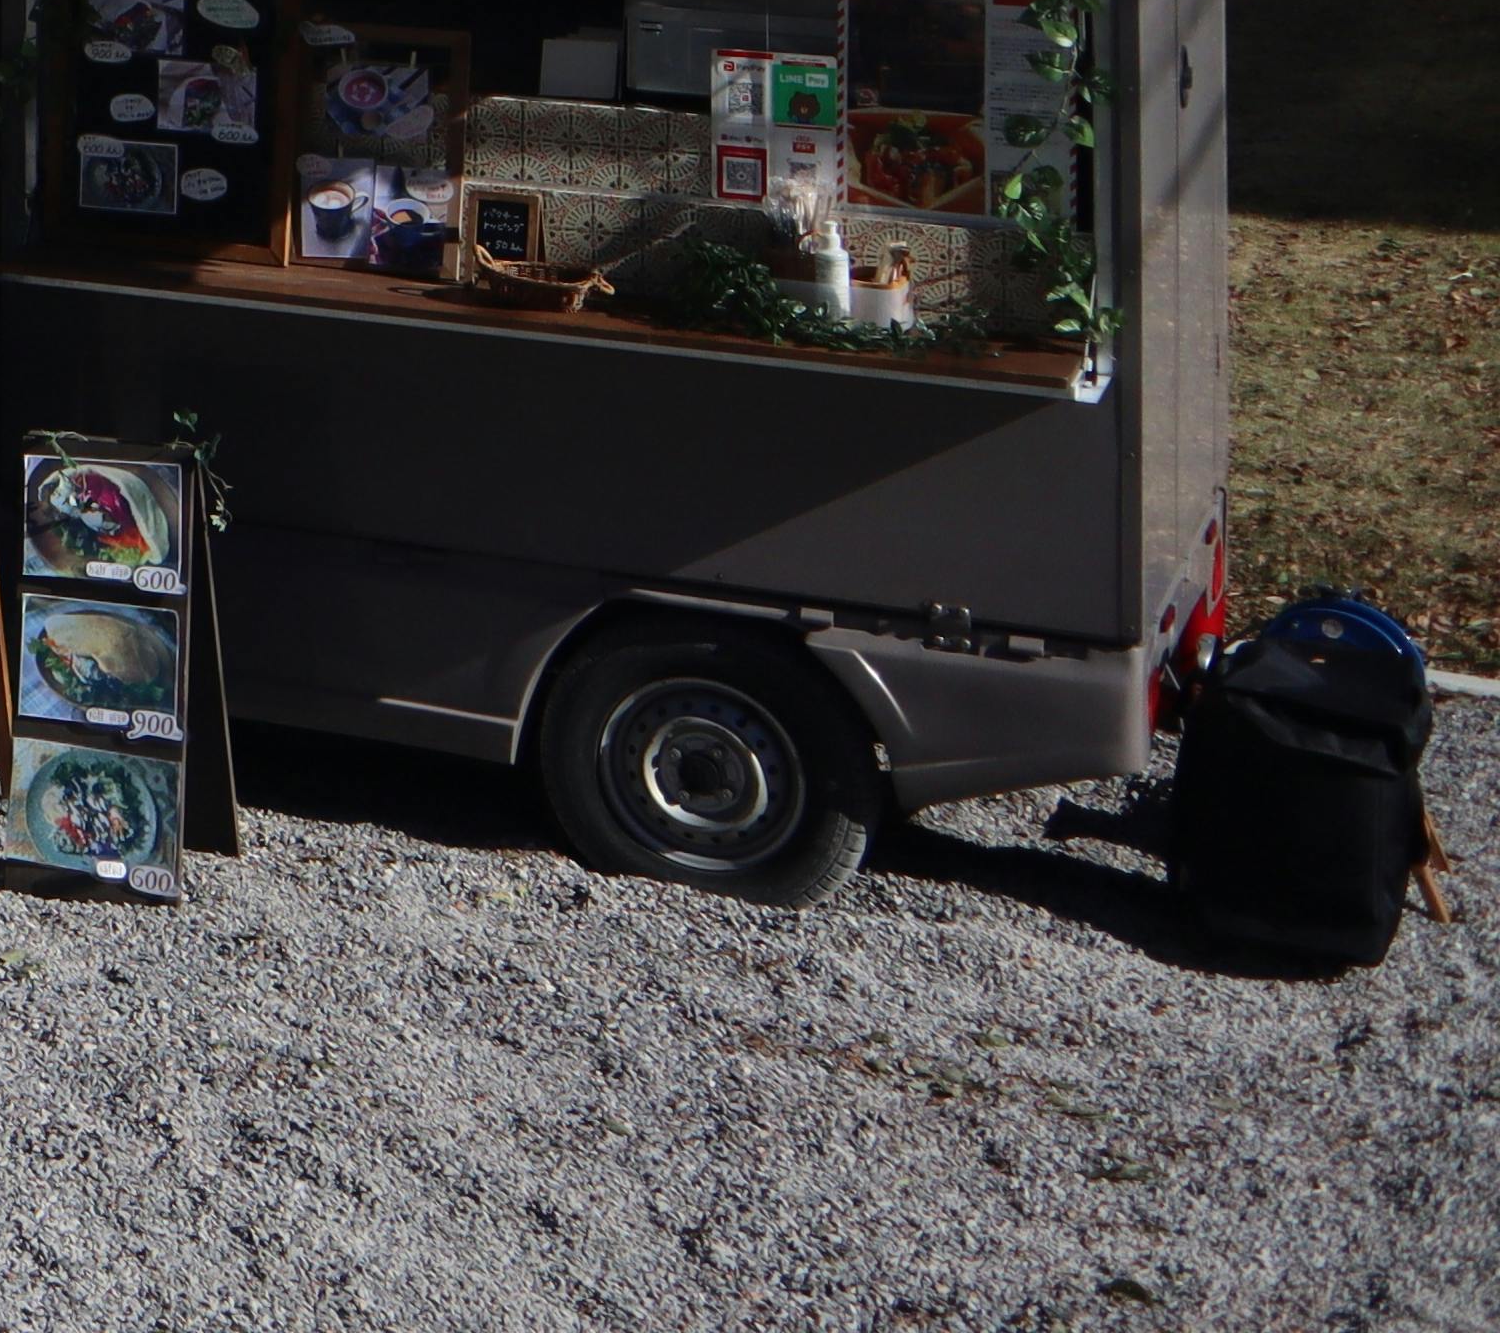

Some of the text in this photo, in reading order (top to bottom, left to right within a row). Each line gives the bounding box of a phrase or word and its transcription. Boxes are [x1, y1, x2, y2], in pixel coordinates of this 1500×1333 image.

[136, 568, 177, 591] 600
[134, 711, 174, 737] 900
[131, 867, 172, 893] 600
